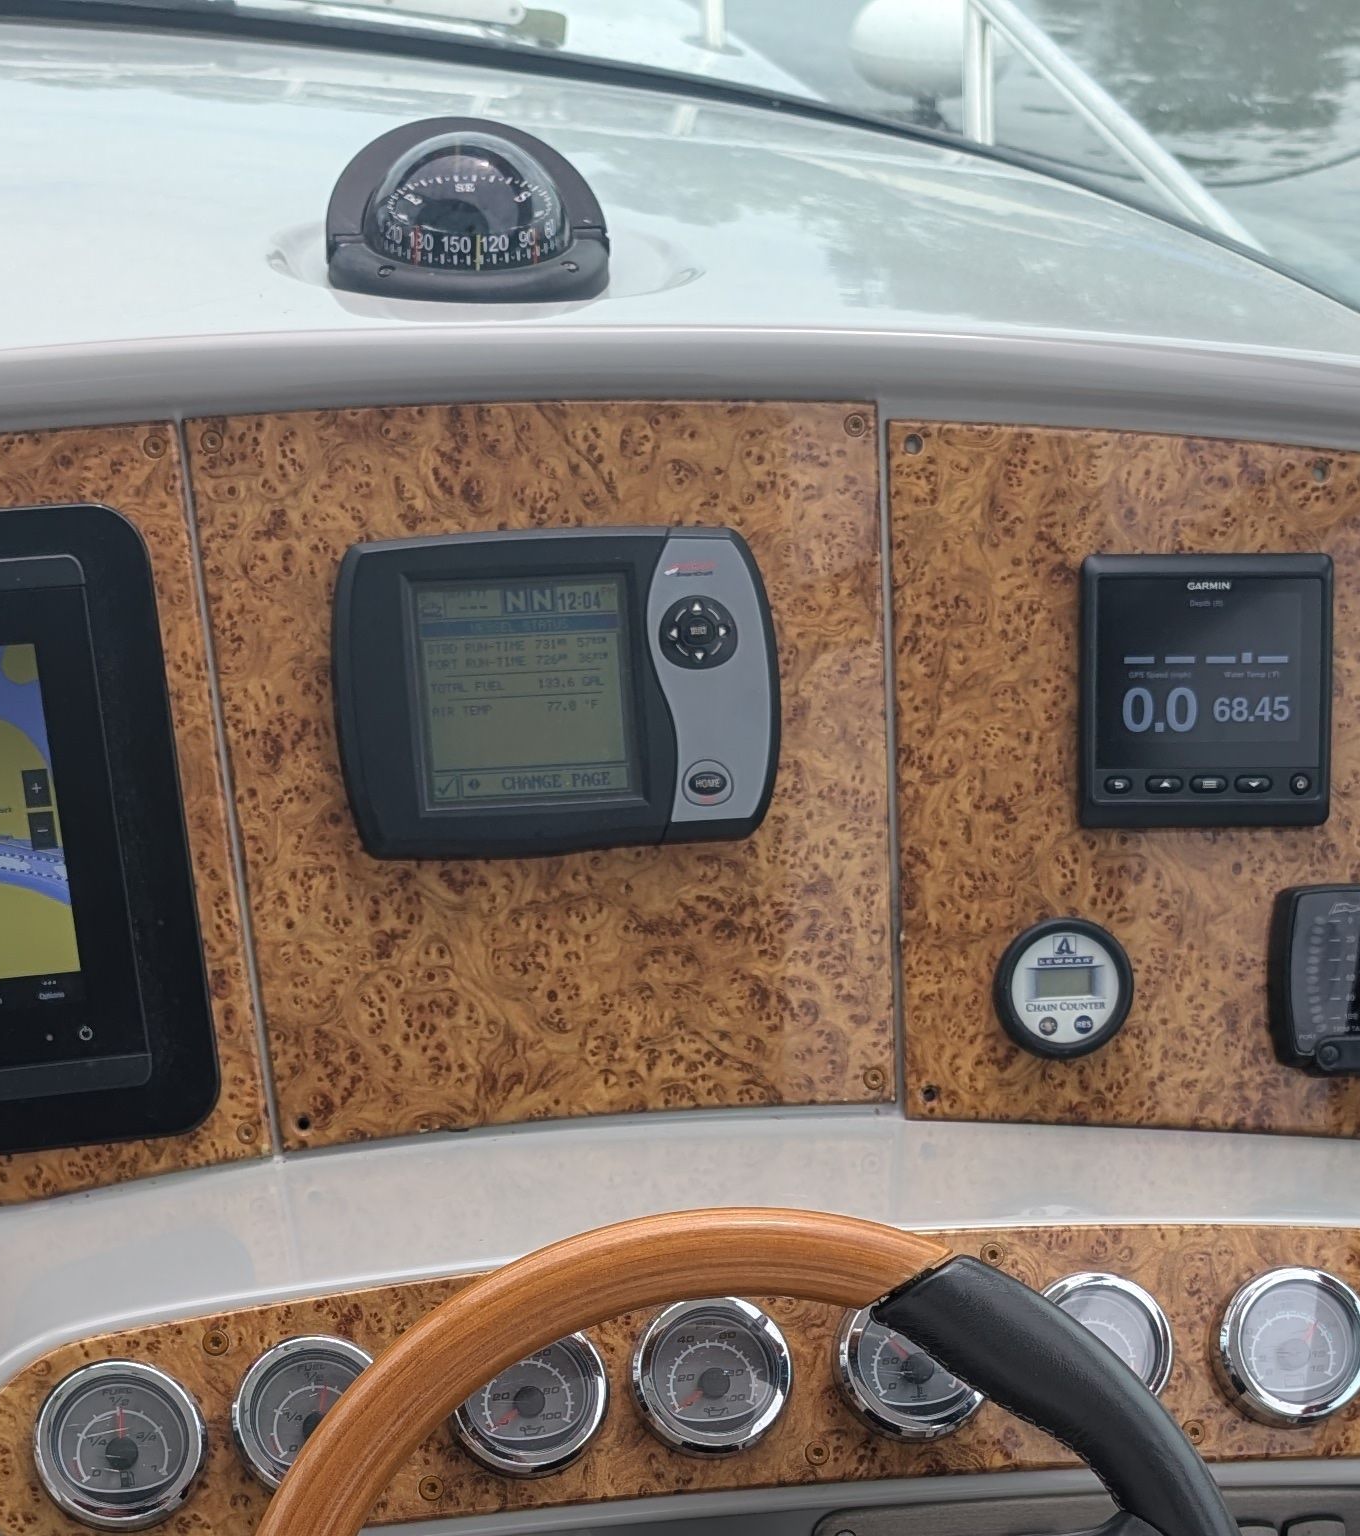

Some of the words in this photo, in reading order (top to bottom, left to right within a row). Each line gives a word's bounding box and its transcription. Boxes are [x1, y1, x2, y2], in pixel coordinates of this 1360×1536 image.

[455, 183, 475, 193] SE
[441, 236, 471, 254] 150
[480, 235, 509, 251] 120
[518, 231, 535, 248] 90
[1187, 581, 1231, 591] GARMIN
[506, 589, 528, 613] N
[531, 588, 552, 612] N
[559, 591, 602, 611] 12:04
[464, 640, 525, 653] RUN-TIME
[427, 659, 457, 670] PORT
[465, 656, 526, 668] RUN-TIME
[431, 682, 466, 693] TOTAL
[474, 681, 505, 692] FUEL
[538, 679, 576, 689] 133.6
[432, 706, 454, 717] AIR
[463, 705, 494, 716] TEMP
[1122, 687, 1198, 733] 0.0
[1213, 696, 1290, 723] 68.45
[501, 774, 563, 793] CHANGE
[571, 771, 612, 788] PAGE
[695, 777, 721, 789] HOME
[1025, 1003, 1058, 1013] CHAIN
[1059, 1001, 1106, 1011] COUNTER
[677, 1335, 694, 1344] 40
[296, 1363, 326, 1373] FUEL
[677, 1373, 695, 1383] 20
[101, 1387, 134, 1396] FUEL
[491, 1391, 510, 1402] 20
[540, 1410, 563, 1420] 100
